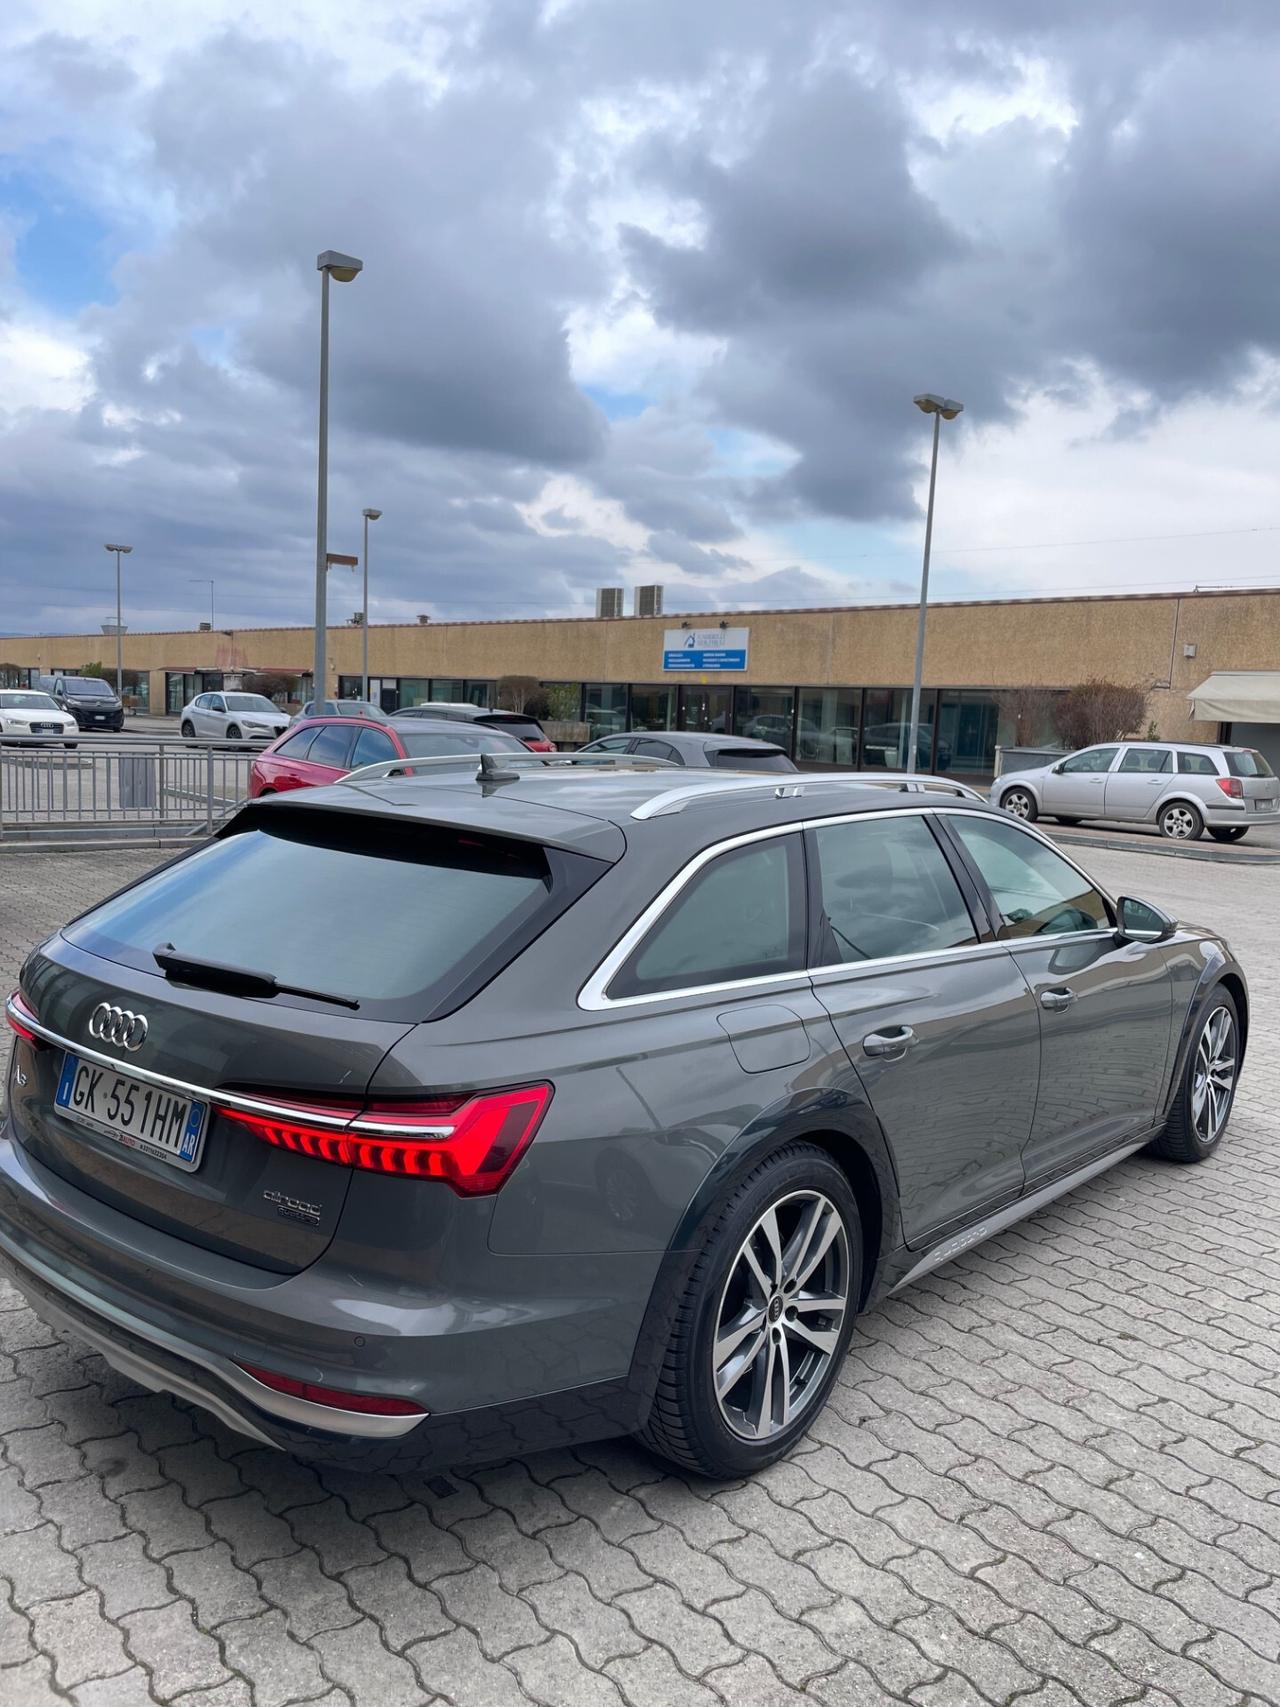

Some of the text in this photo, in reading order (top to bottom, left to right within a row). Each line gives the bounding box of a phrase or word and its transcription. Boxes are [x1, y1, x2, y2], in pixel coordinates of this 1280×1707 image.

[73, 1065, 188, 1148] GK 551HM
[182, 1132, 196, 1156] AR
